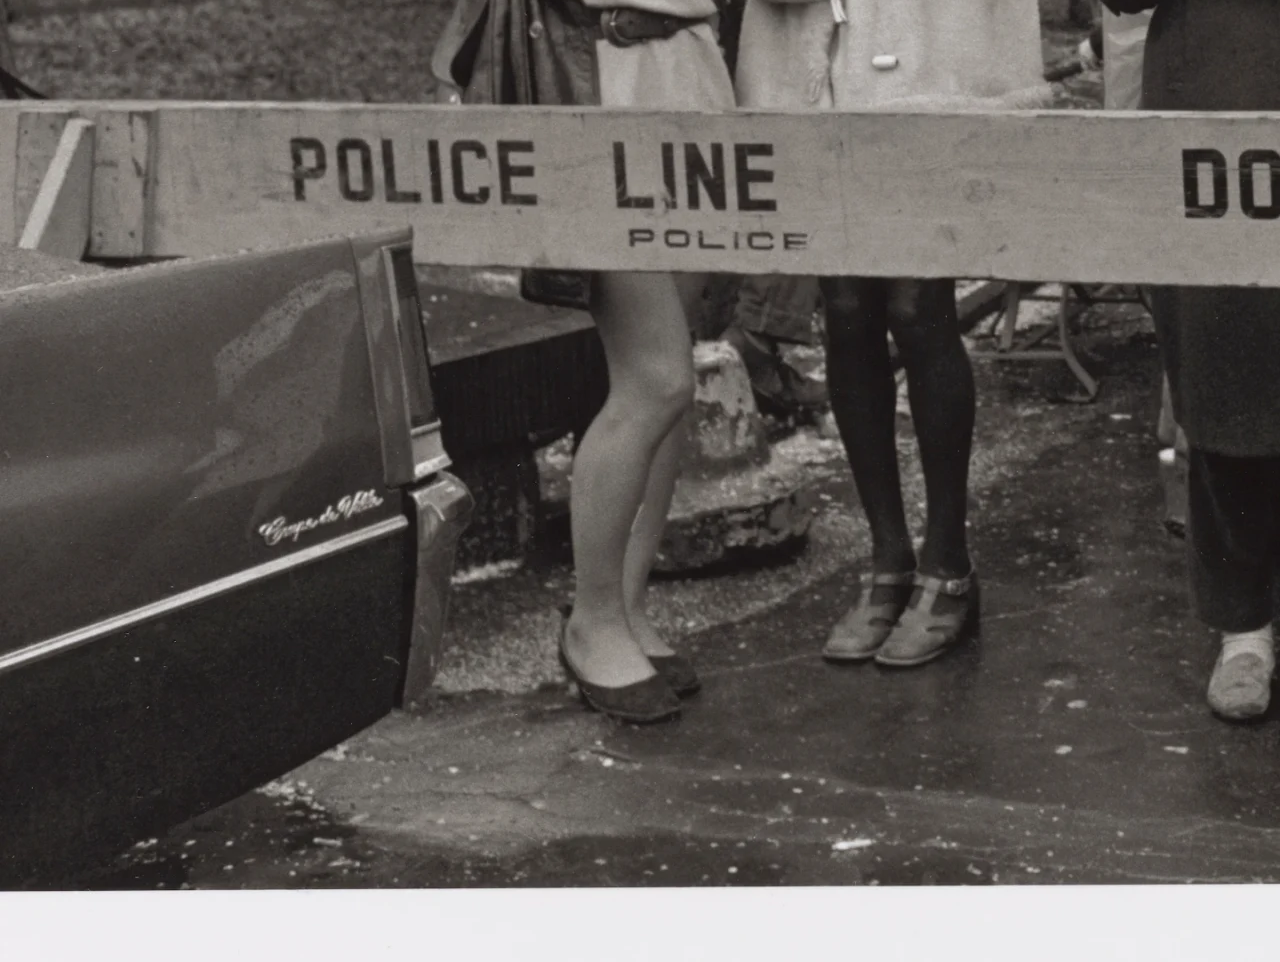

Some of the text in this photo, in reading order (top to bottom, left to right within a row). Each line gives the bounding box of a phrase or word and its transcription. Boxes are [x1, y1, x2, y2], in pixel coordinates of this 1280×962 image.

[290, 137, 538, 206] POLICE
[612, 141, 777, 212] LINE
[628, 229, 810, 251] POLICE
